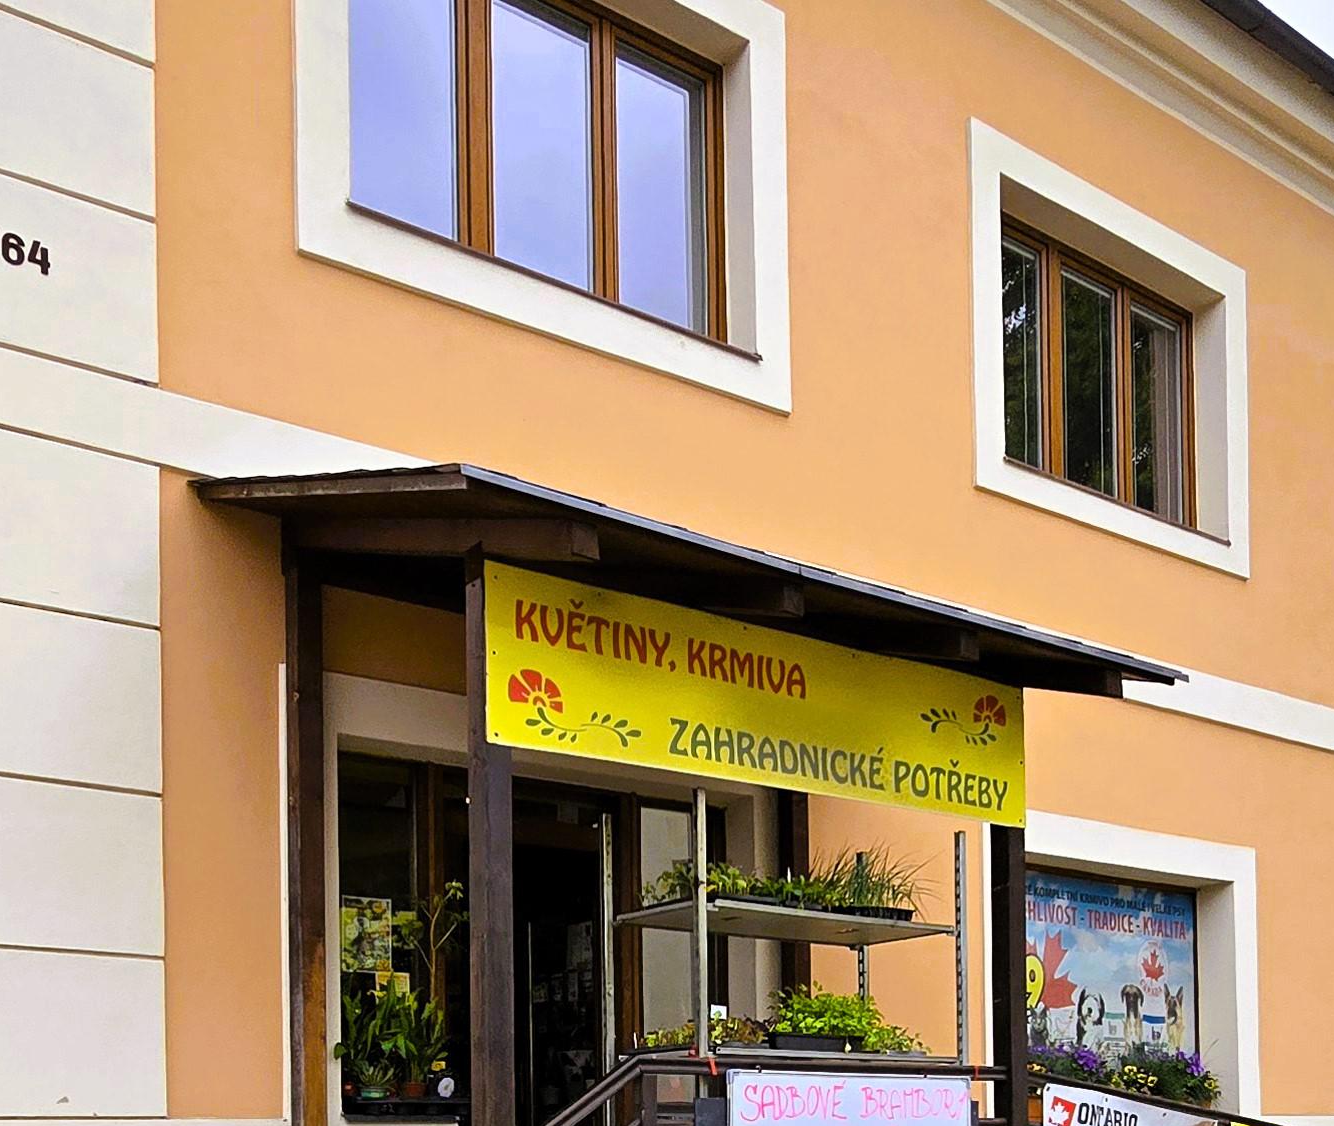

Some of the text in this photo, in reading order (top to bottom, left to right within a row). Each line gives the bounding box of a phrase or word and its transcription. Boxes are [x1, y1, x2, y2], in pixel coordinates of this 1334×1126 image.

[515, 598, 807, 699] KVĚTINY, KRMIVA
[668, 717, 1008, 811] ZAHRADNICKÉ POTŘEBY
[1087, 908, 1134, 934] TRADICE
[1142, 916, 1186, 940] KVALITA
[740, 1080, 848, 1122] SADBOVÉ
